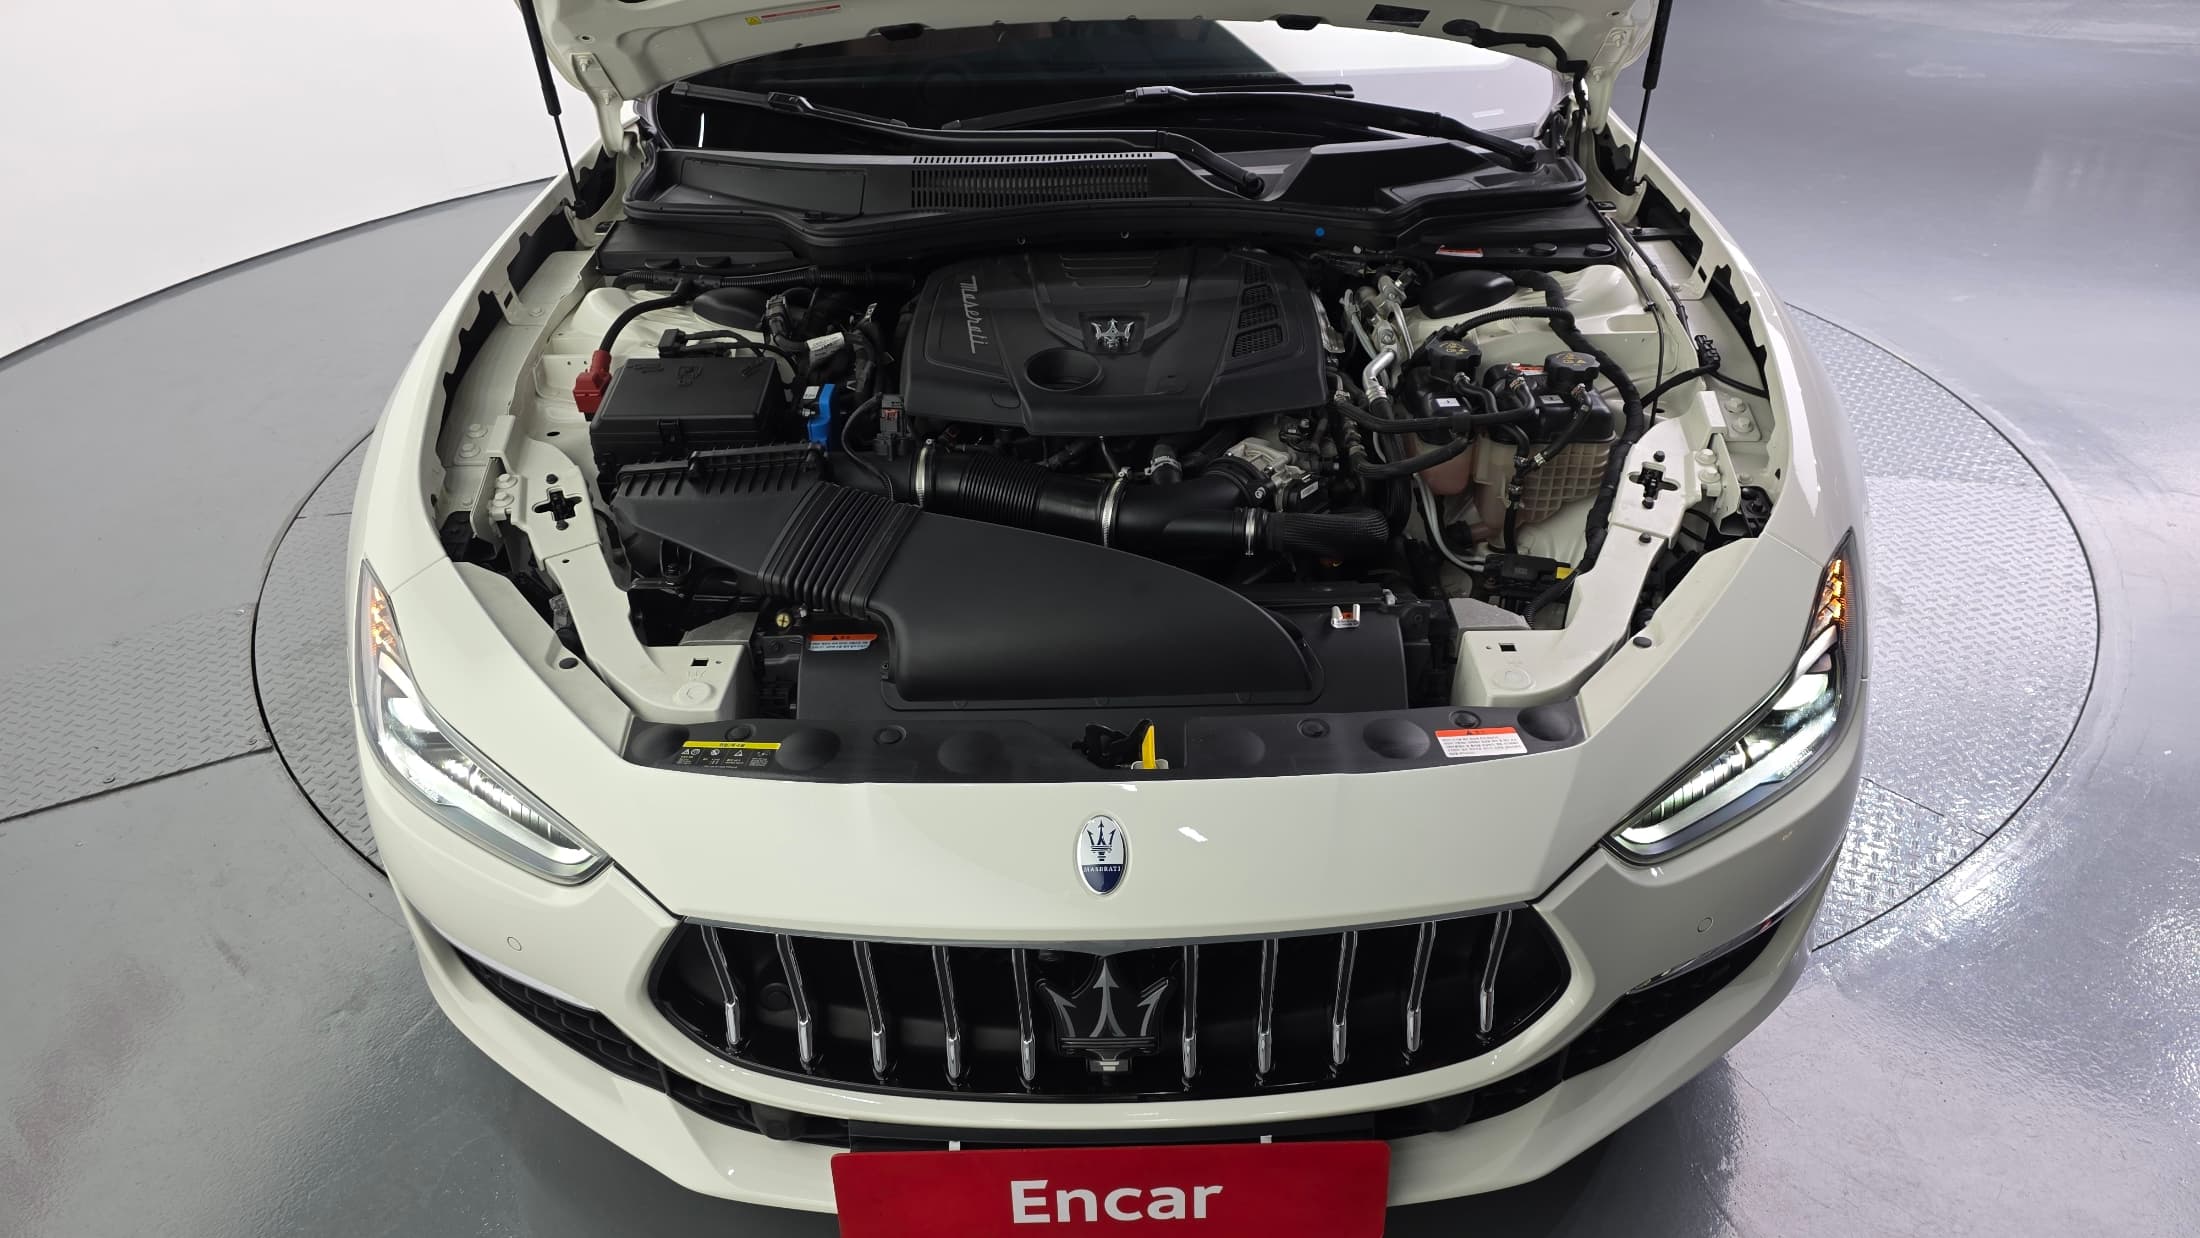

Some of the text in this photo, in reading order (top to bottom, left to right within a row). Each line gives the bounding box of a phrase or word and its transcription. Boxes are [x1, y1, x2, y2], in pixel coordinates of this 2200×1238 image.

[960, 274, 988, 354] Maserati
[1083, 865, 1121, 873] MASERATI
[1010, 1179, 1224, 1224] Encar
